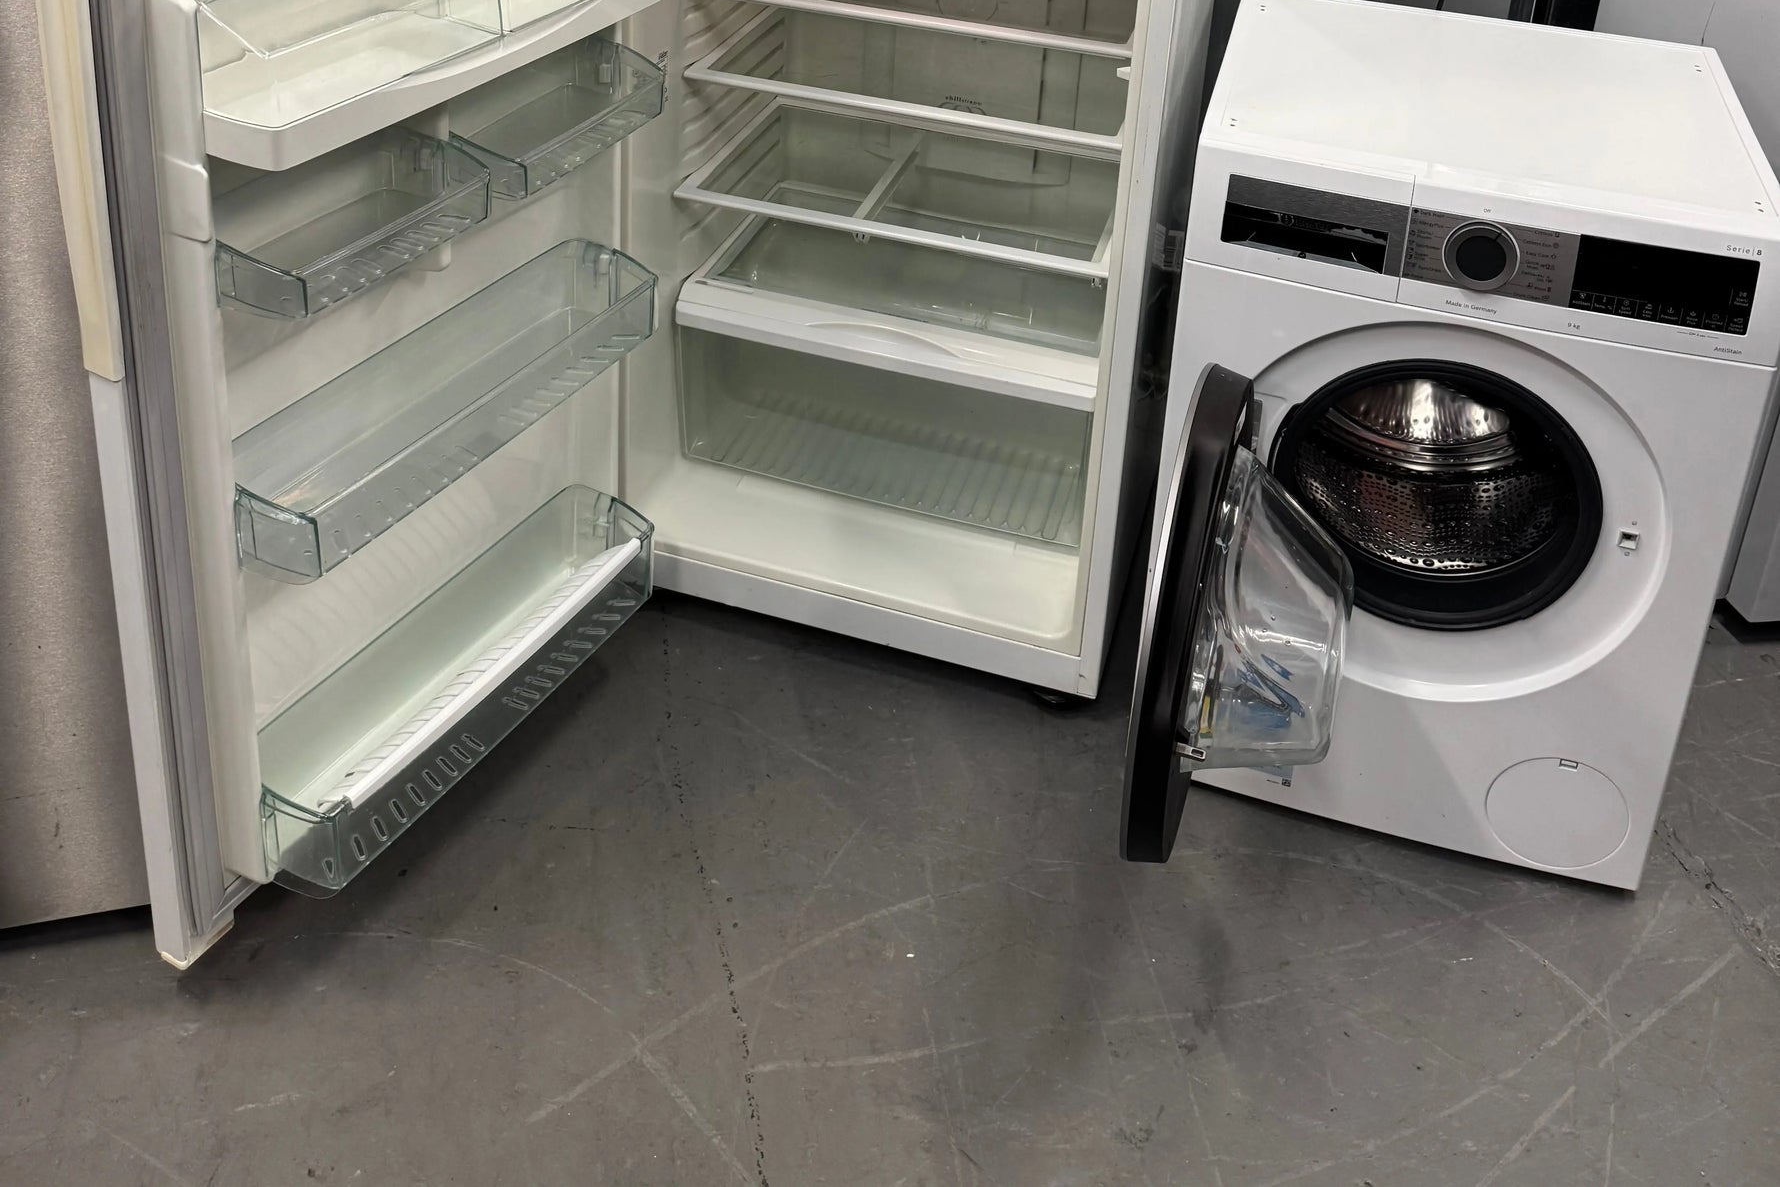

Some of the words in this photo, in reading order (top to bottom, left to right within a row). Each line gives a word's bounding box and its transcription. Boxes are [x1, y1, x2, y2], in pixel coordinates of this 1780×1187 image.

[1445, 299, 1462, 308] Made
[1463, 302, 1470, 310] in
[1470, 304, 1497, 315] Germany
[1713, 346, 1743, 355] AntiStain
